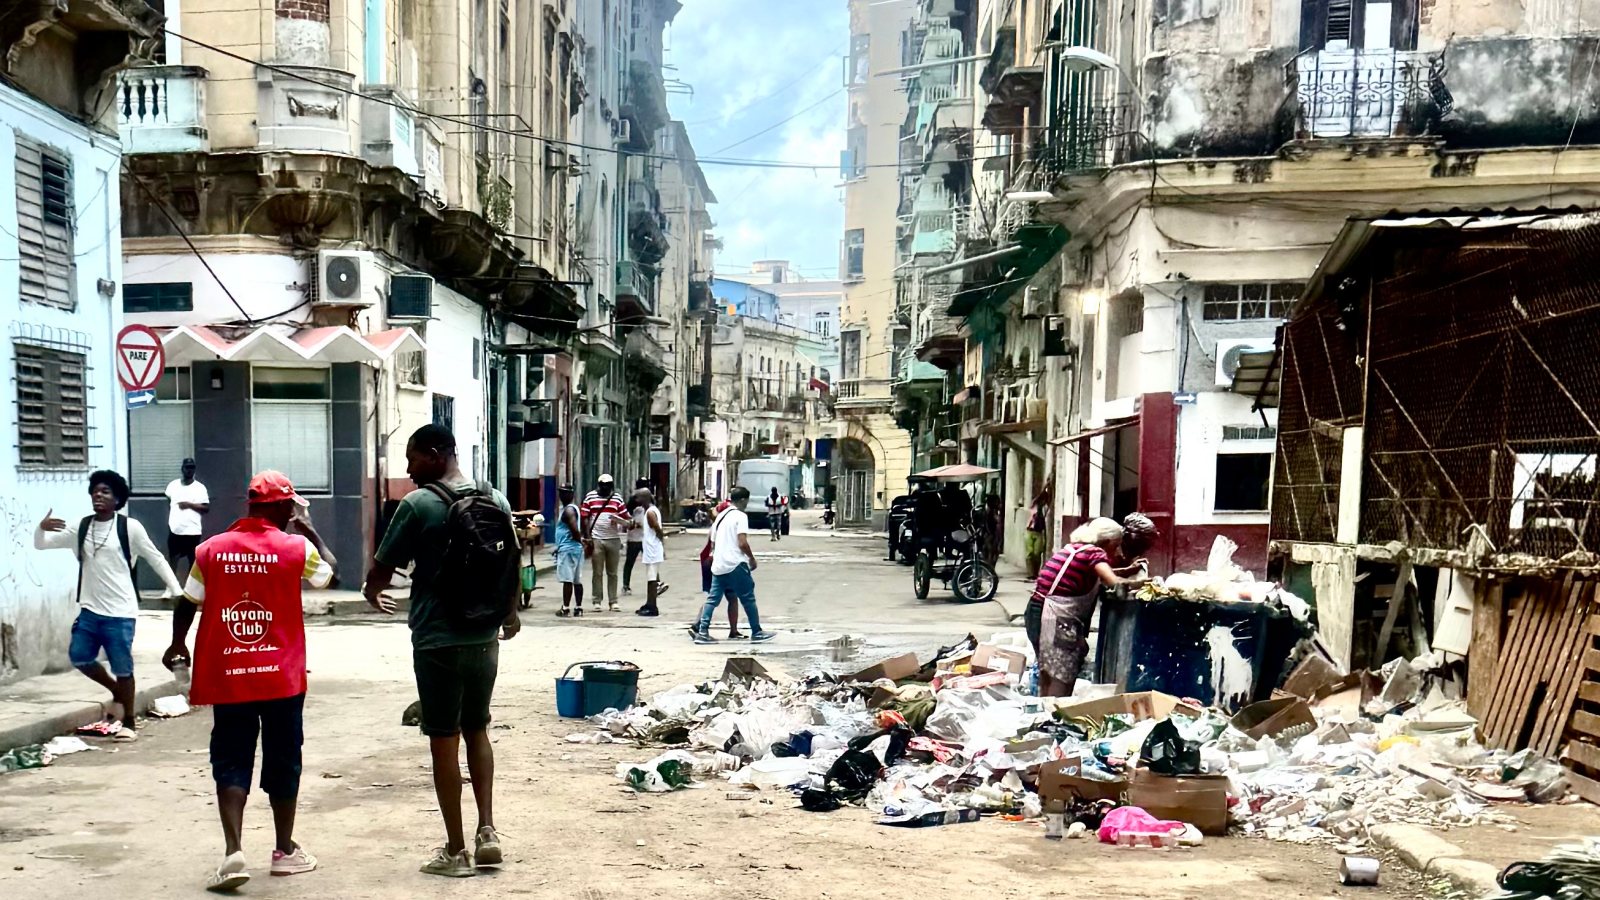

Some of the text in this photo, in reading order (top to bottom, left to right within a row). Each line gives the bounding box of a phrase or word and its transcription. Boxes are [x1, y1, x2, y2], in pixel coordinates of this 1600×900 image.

[129, 351, 147, 360] PARE
[216, 552, 278, 563] PARQUEADOR
[224, 564, 268, 574] ESTATAL
[221, 607, 273, 622] Havana
[233, 621, 263, 636] Club
